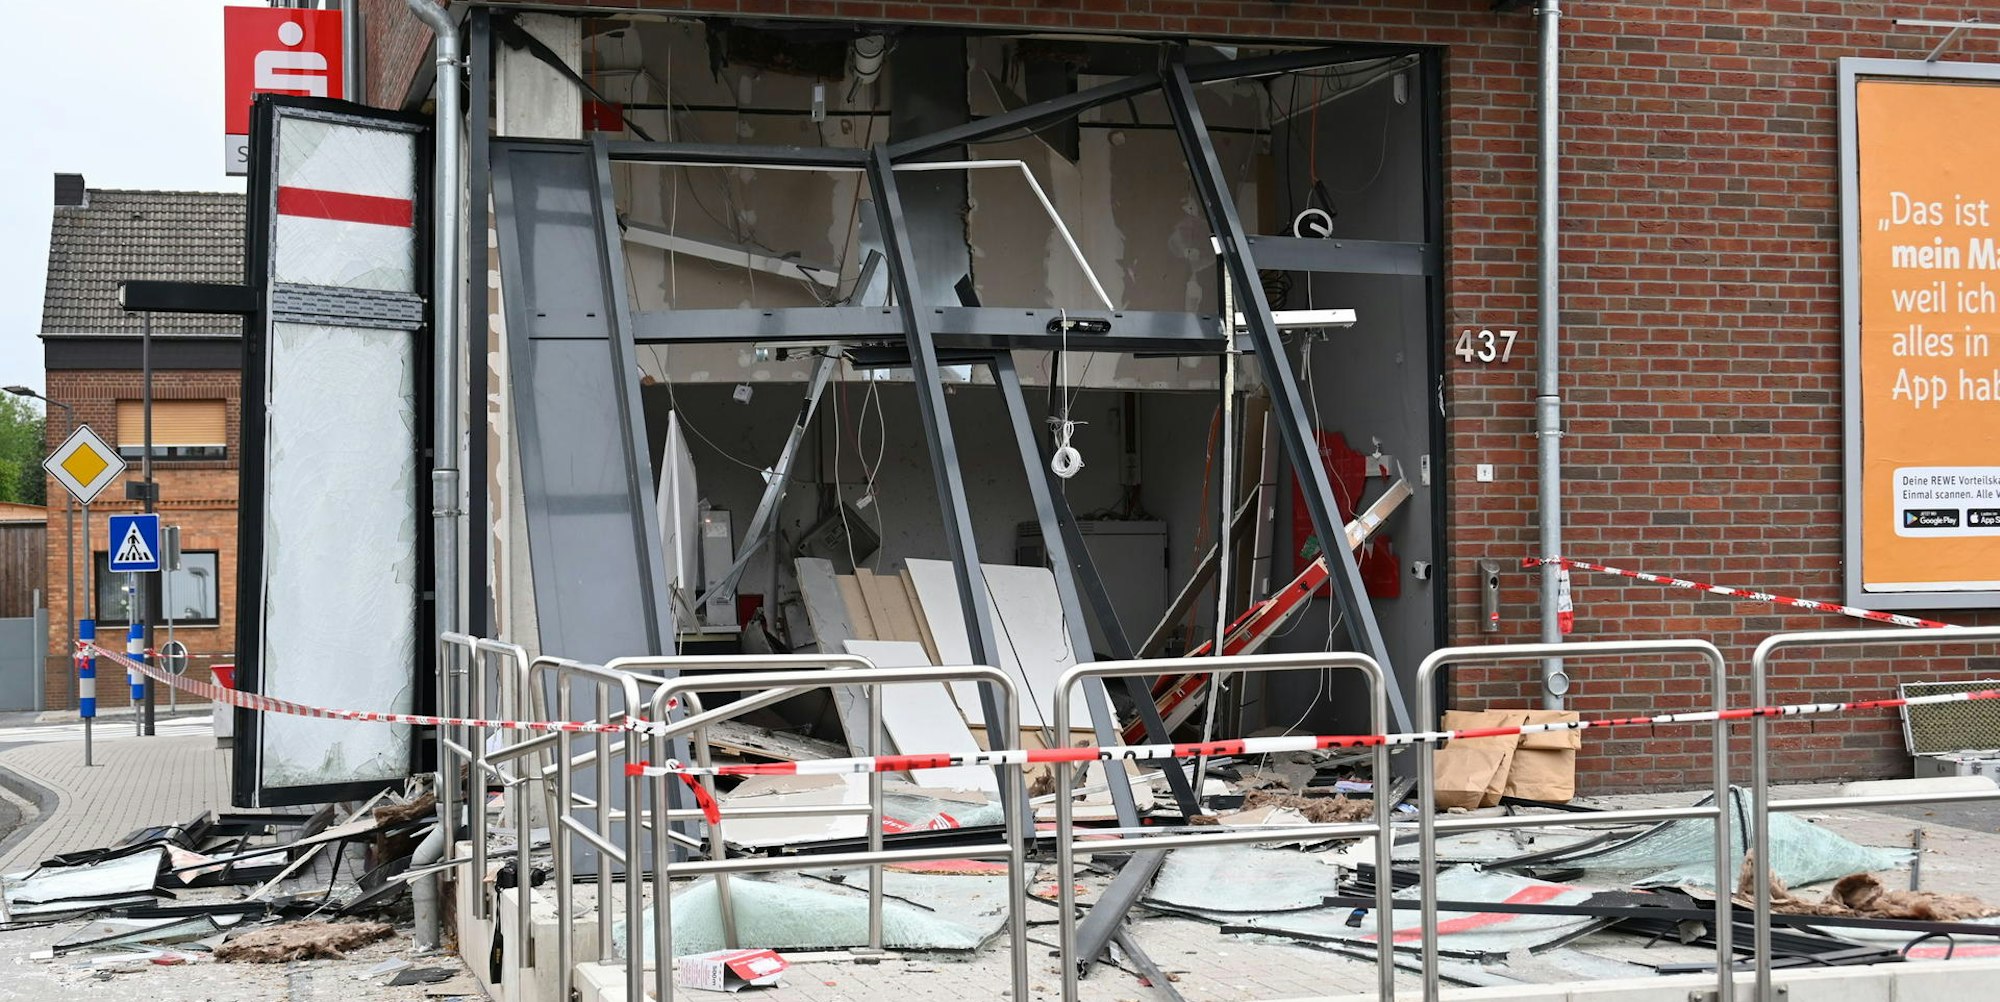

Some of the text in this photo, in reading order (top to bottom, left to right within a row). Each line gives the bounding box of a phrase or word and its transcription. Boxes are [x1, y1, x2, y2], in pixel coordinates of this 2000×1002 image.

[1878, 191, 1990, 232] „Das ist
[1892, 236, 2000, 270] mein M
[1892, 281, 1996, 314] weil ich
[1455, 329, 1518, 363] 437
[1892, 324, 1989, 358] alles in
[1892, 368, 1948, 409] App
[1902, 475, 1928, 486] Deine
[1931, 475, 1956, 486] REWE
[1902, 489, 1933, 500] Einmal
[1935, 490, 1974, 500] scannen.
[1976, 489, 1993, 499] Alle
[1919, 515, 1957, 526] Google Play
[1980, 516, 1995, 525] App
